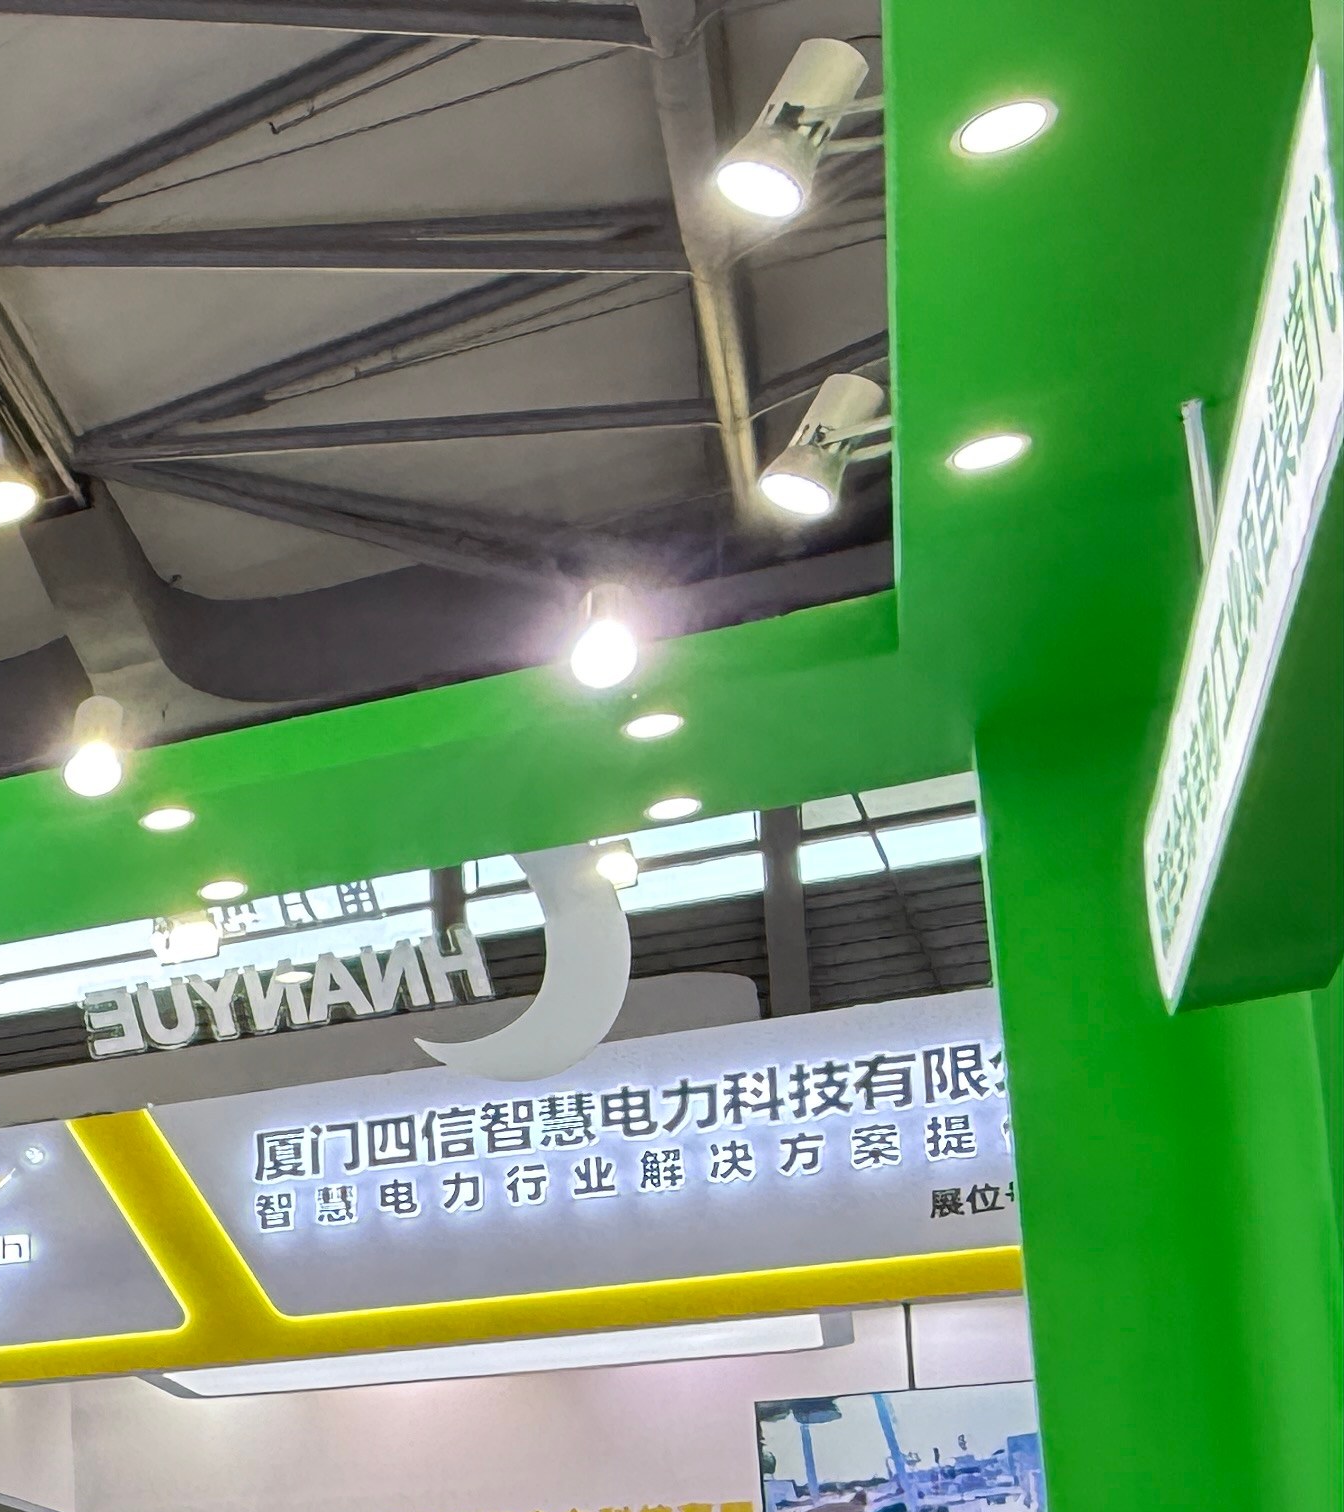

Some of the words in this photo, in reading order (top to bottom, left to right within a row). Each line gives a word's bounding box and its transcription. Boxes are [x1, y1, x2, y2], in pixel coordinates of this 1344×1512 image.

[255, 1113, 1012, 1231] 智慧电力行业解决方案提
[930, 1181, 1014, 1219] 展位
